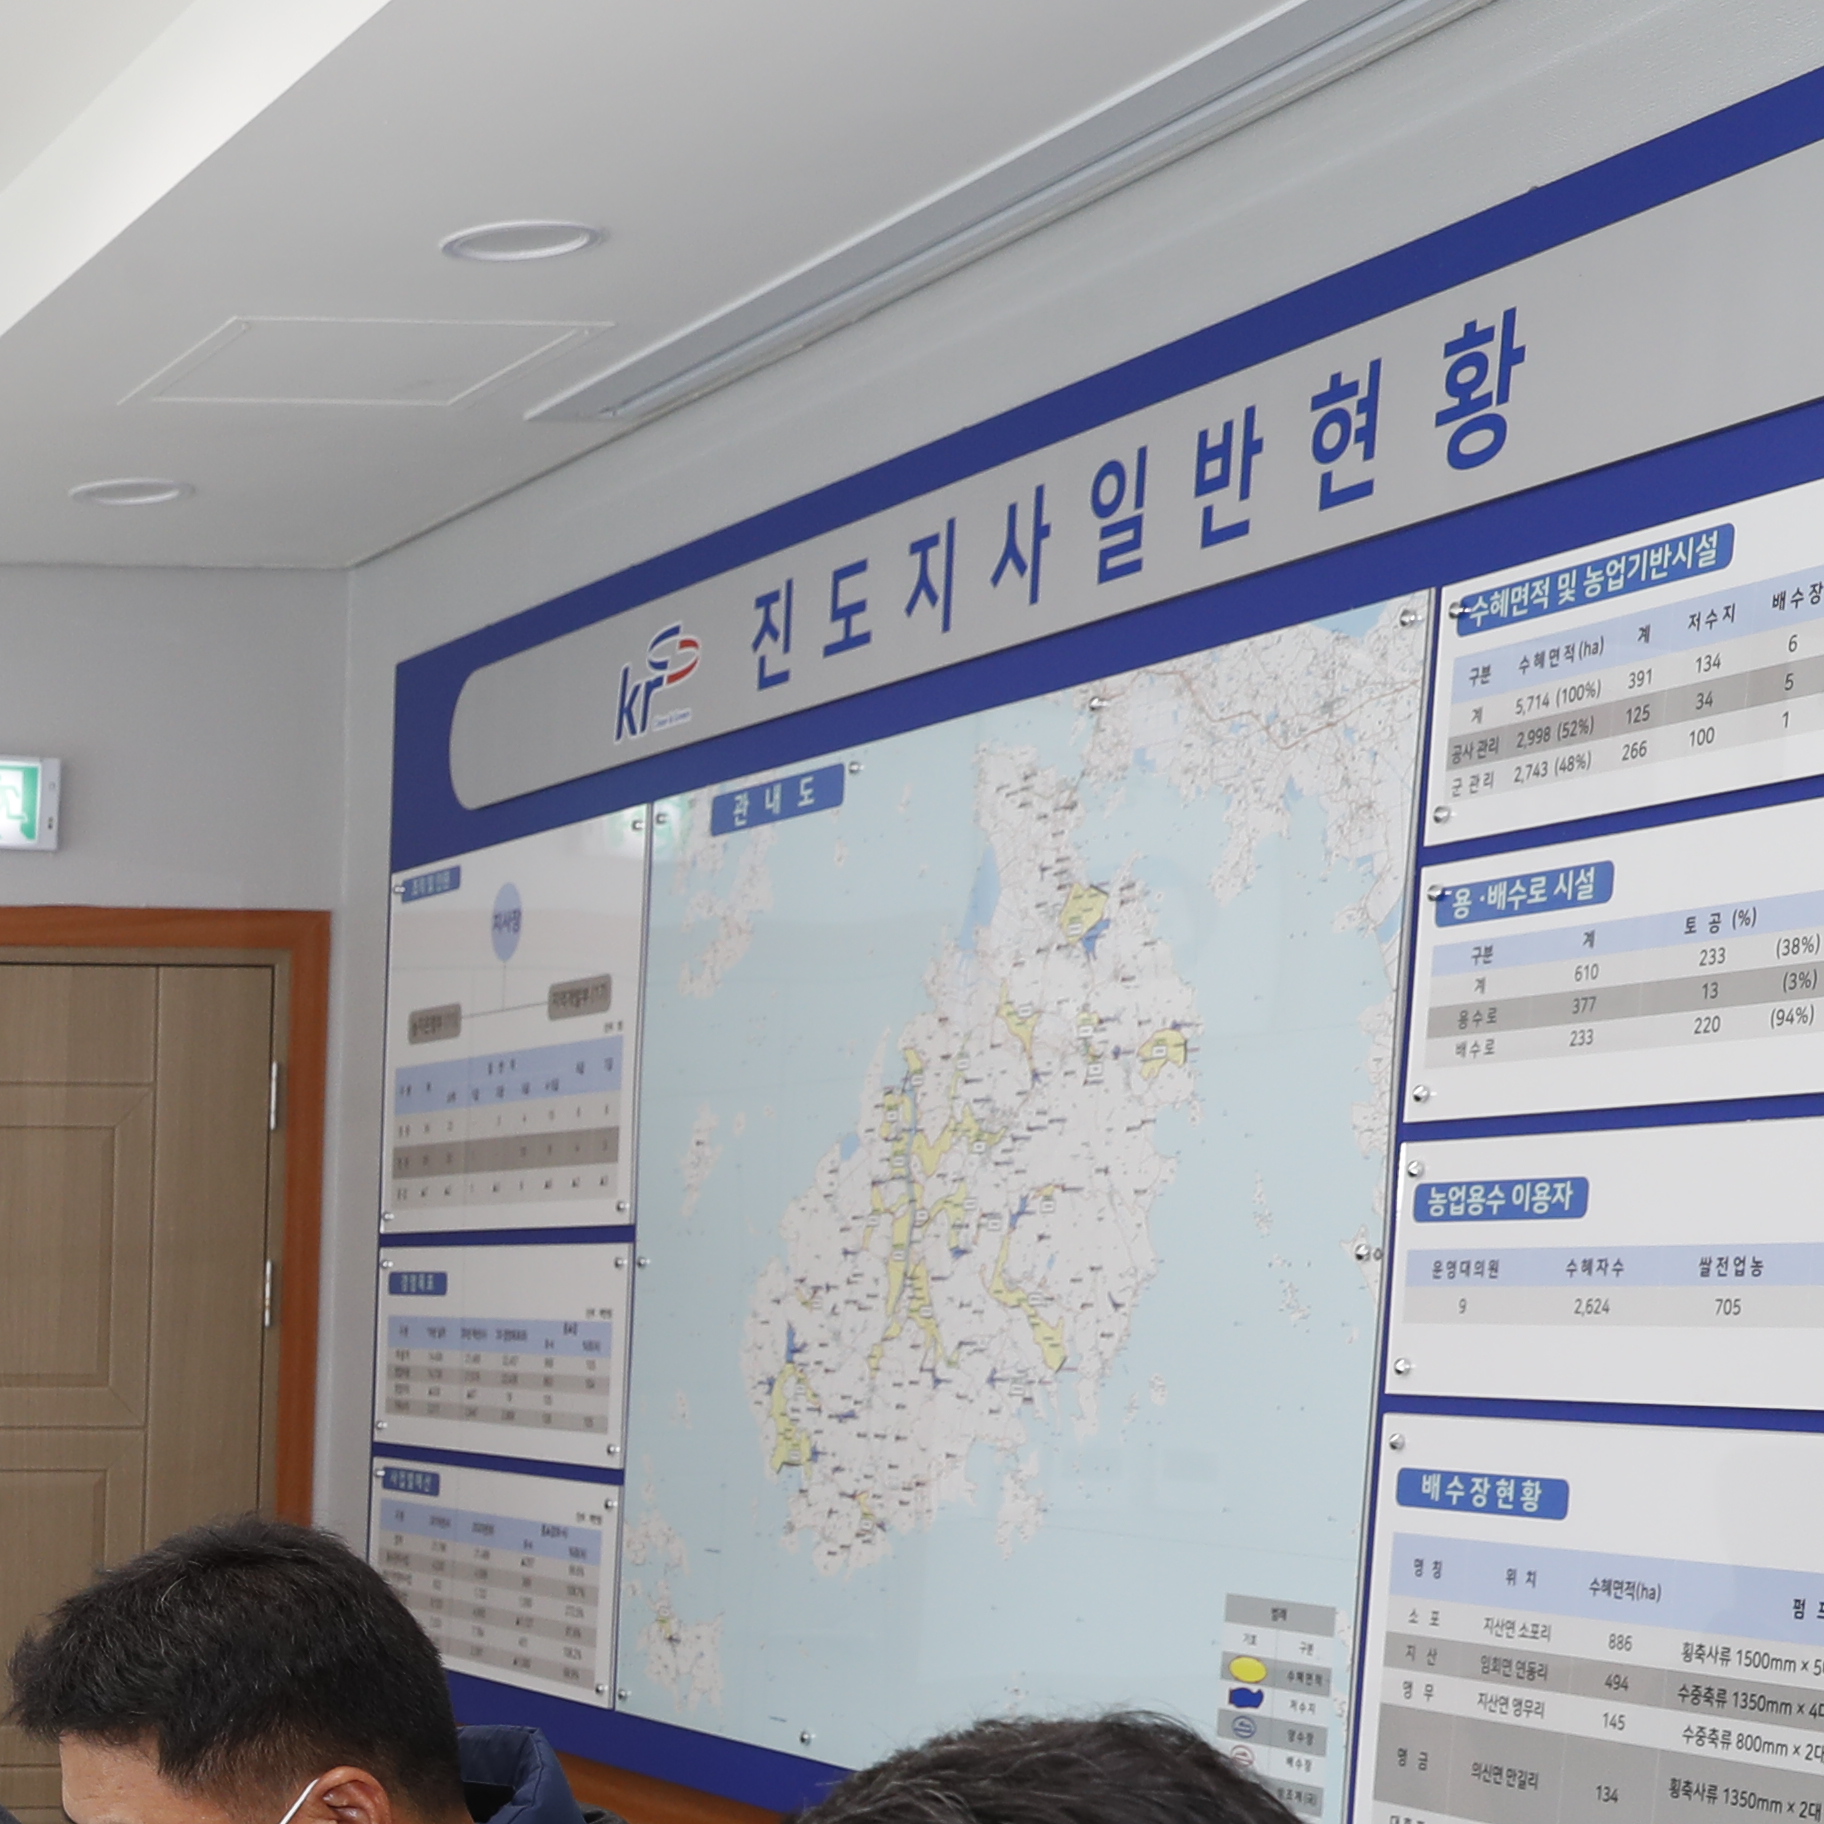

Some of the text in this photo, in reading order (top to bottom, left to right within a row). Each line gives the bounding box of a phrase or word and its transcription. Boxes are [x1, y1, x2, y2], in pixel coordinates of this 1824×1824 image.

[1469, 530, 1719, 628] 수혜면적 및 농업기반시설
[1468, 582, 1822, 687] 구분 수혜면적(ha) 계 저수지 배수장
[1470, 634, 1798, 725] 계 5,714 (100%) 391 134 6
[1451, 672, 1795, 765] 공사 관리 2,998 (52%) 125 34 5
[1451, 711, 1790, 798] 군 관리 2,743 (48%) 266 100 1
[733, 775, 815, 827] 관내도
[1554, 865, 1597, 901] 시설
[1470, 943, 1495, 966] 구분
[1582, 929, 1596, 949] 계
[1731, 906, 1758, 931] (%)
[1473, 932, 1822, 996] 계 610 233 (38%)
[1455, 1003, 1816, 1060] 배수로 233 220 (94%)
[1456, 969, 1818, 1032] 용수로 377 13 (3%)
[1426, 1179, 1575, 1218] 농업용수 이용자
[1565, 1255, 1626, 1279] 수혜자수
[1697, 1253, 1765, 1280] 쌀전업농
[1457, 1297, 1742, 1319] 9 2,624 705
[1420, 1472, 1543, 1514] 배수장현황
[1505, 1567, 1538, 1589] 위치
[1588, 1575, 1663, 1605] 수혜면적(ha)
[1408, 1608, 1798, 1675] 소포 지산면 소포리 886 횡축사류 1500mm
[1405, 1644, 1439, 1667] 지산
[1604, 1673, 1630, 1694] 494
[1677, 1682, 1729, 1709] 수중축류
[1731, 1689, 1794, 1718] 1350mm
[1476, 1690, 1510, 1714] 지산면
[1602, 1711, 1626, 1732] 145
[1681, 1723, 1733, 1752] 수중축류
[1735, 1729, 1790, 1758] 800mm
[1470, 1760, 1504, 1786] 의신면
[1595, 1784, 1620, 1804] 134
[1668, 1777, 1719, 1804] 횡축사류
[1721, 1786, 1784, 1815] 1350mm
[1798, 1799, 1824, 1823] 2대
